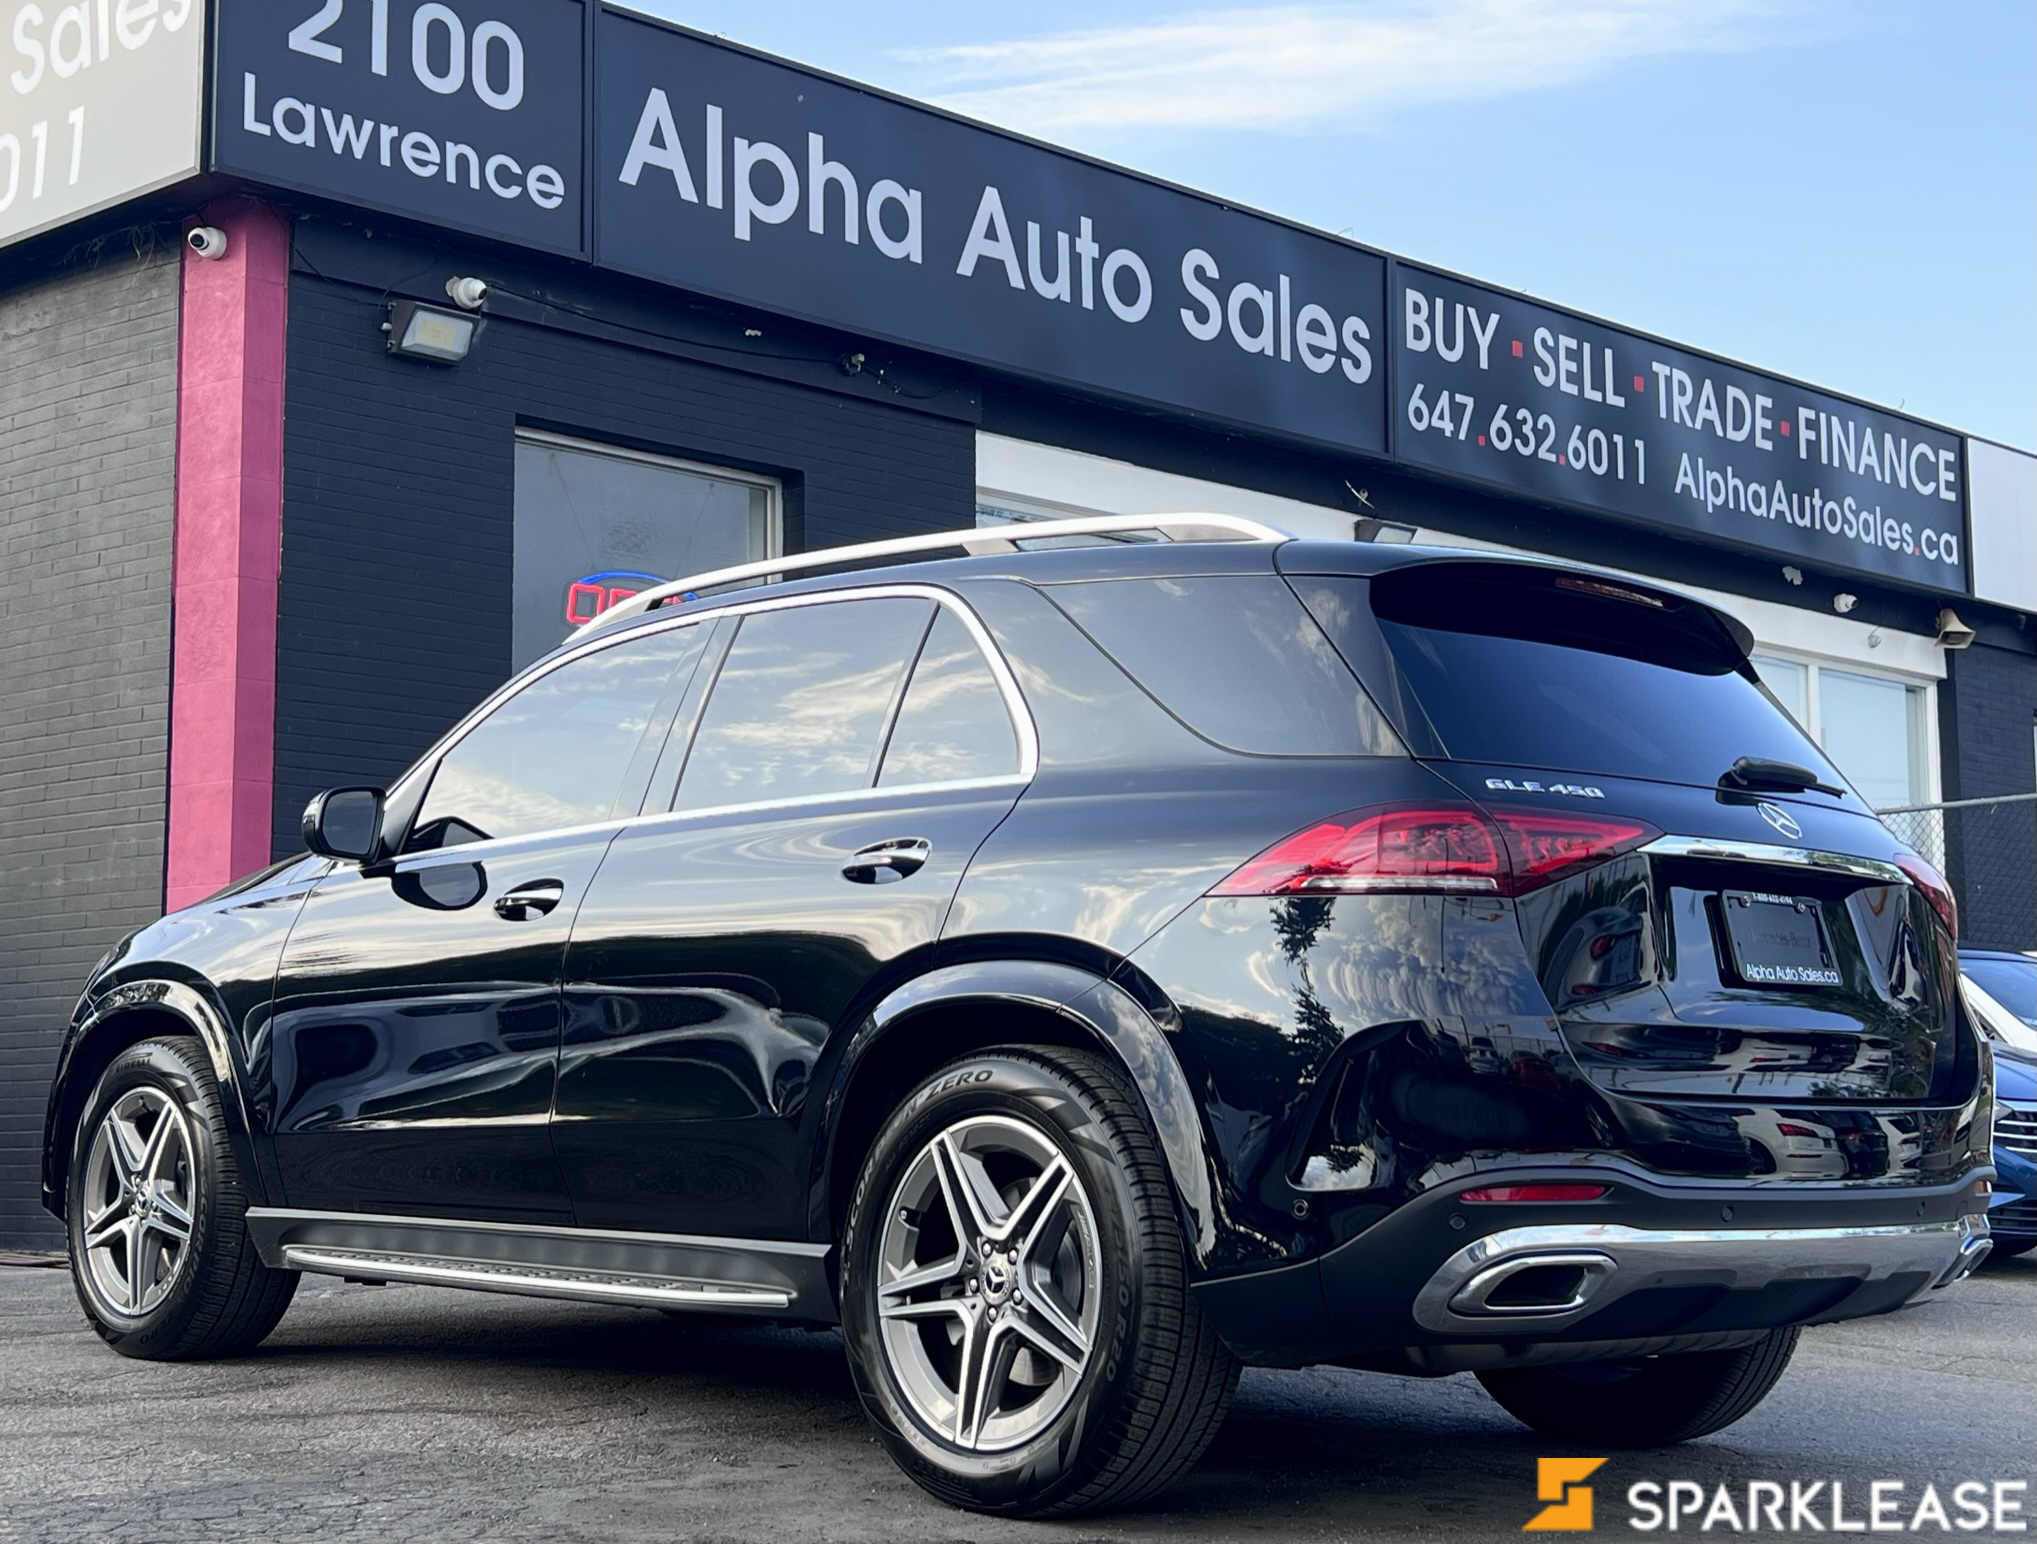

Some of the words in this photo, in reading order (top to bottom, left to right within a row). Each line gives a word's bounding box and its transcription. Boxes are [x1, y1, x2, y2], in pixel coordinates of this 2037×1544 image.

[288, 0, 524, 111] 2100
[243, 72, 565, 210] Lawrence
[619, 87, 923, 264] Alpha
[956, 186, 1153, 323] Auto
[1180, 248, 1372, 384] Sales
[1405, 287, 1500, 369] BUY
[1533, 326, 1625, 408] SELL
[1651, 361, 1773, 451] TRADE
[1798, 406, 1957, 502] FINANCE
[1407, 383, 1646, 485] 647.632.6011
[1674, 452, 1959, 565] AlphaAutoSales.ca
[1485, 778, 1545, 793] GLE
[1549, 783, 1605, 799] 450
[1746, 963, 1775, 981] Alpha
[1776, 965, 1799, 981] Auto
[927, 1069, 994, 1099] ZERO
